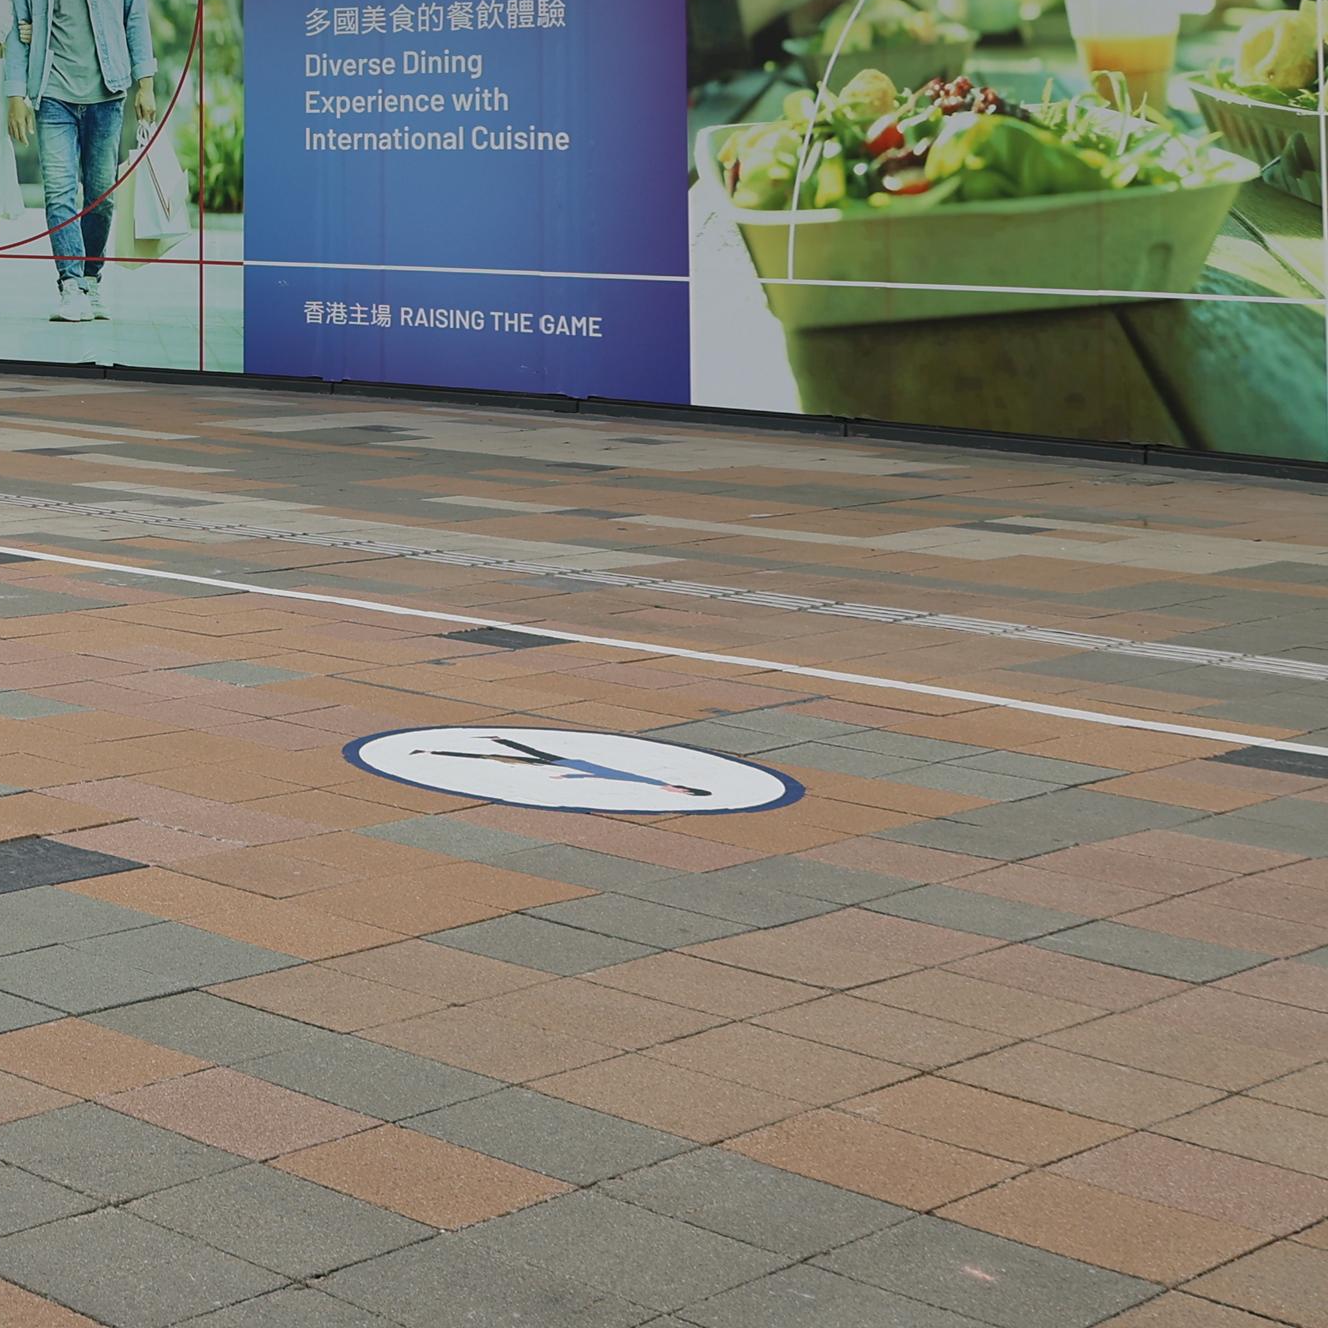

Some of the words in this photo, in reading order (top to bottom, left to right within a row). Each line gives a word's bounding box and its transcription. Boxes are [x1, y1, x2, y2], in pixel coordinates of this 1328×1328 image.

[305, 53, 396, 77] Diverse
[403, 49, 483, 79] Dining
[305, 89, 444, 119] Experience
[452, 87, 509, 112] with
[305, 125, 464, 150] International
[471, 125, 570, 151] Cuisine
[304, 300, 392, 328] 香港主場
[400, 307, 484, 330] RAISING
[490, 311, 534, 333] THE
[539, 314, 603, 337] GAME
